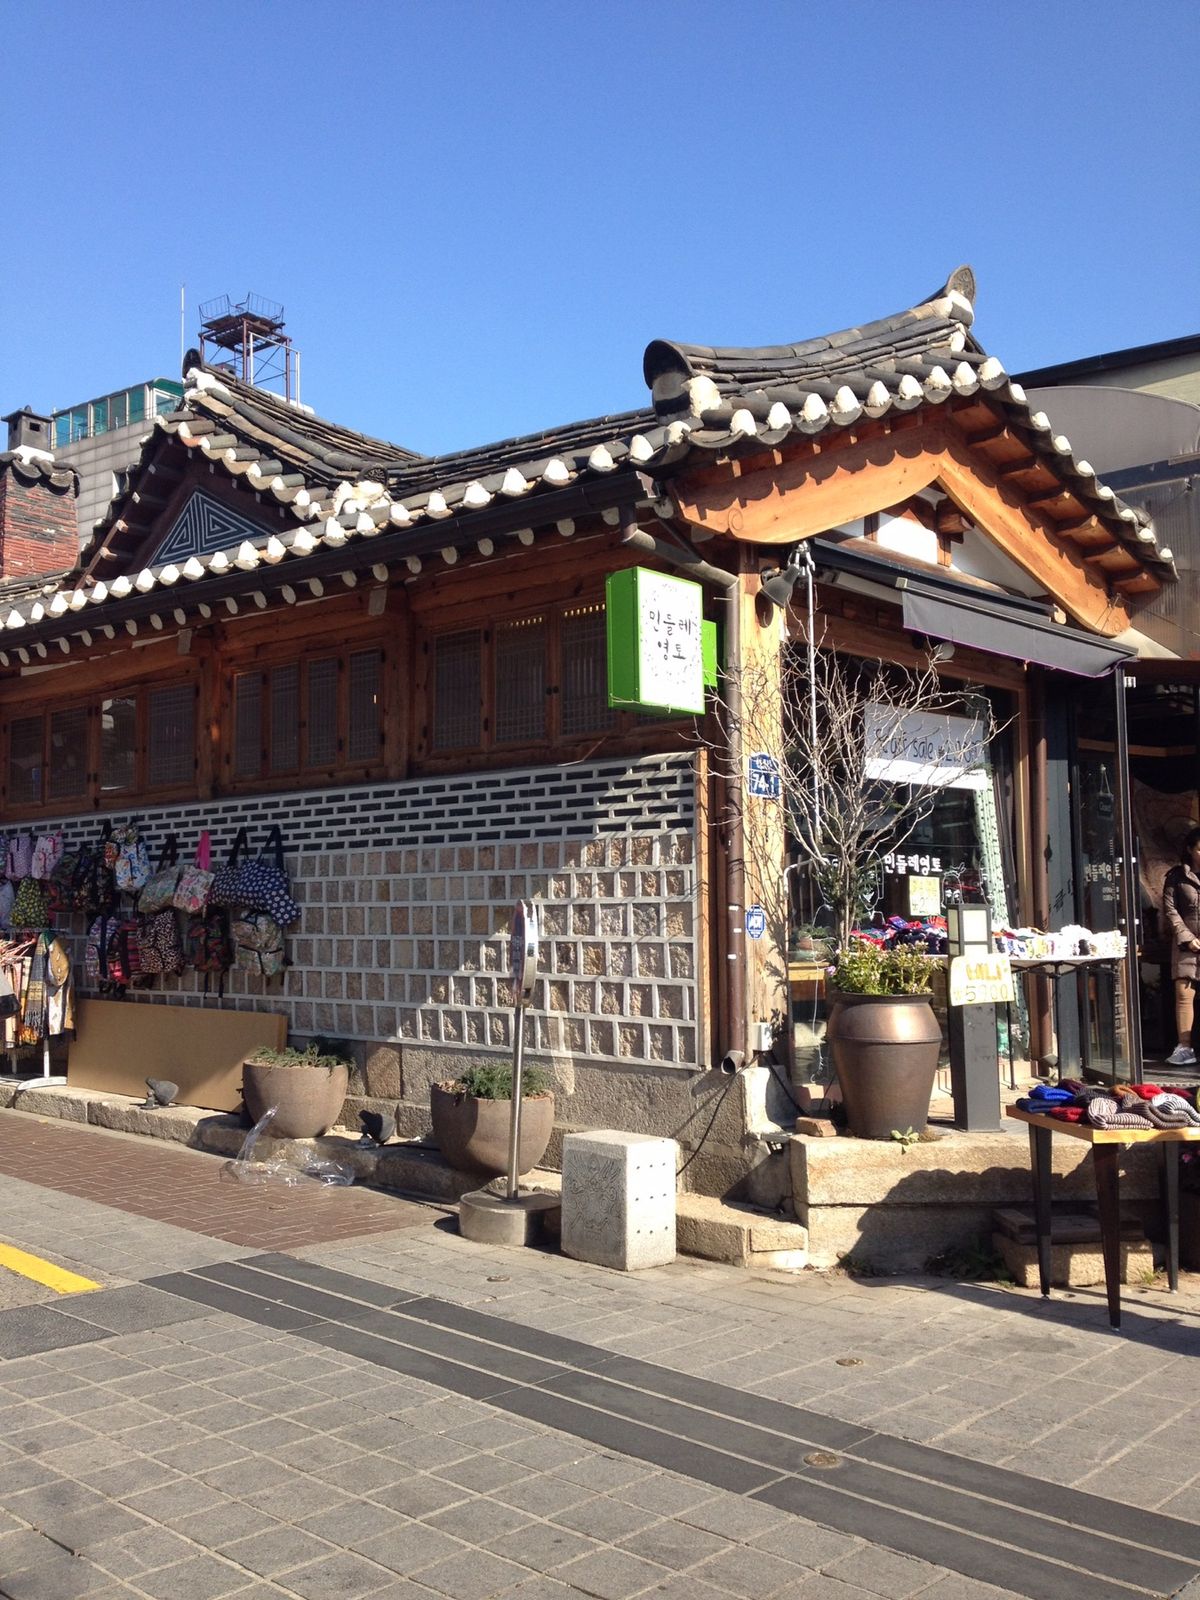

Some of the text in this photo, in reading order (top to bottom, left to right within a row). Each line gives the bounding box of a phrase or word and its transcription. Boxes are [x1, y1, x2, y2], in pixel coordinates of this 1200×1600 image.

[649, 610, 692, 636] 민들레
[657, 639, 687, 661] 영토
[913, 737, 934, 760] sale
[883, 852, 943, 875] 민들레영토
